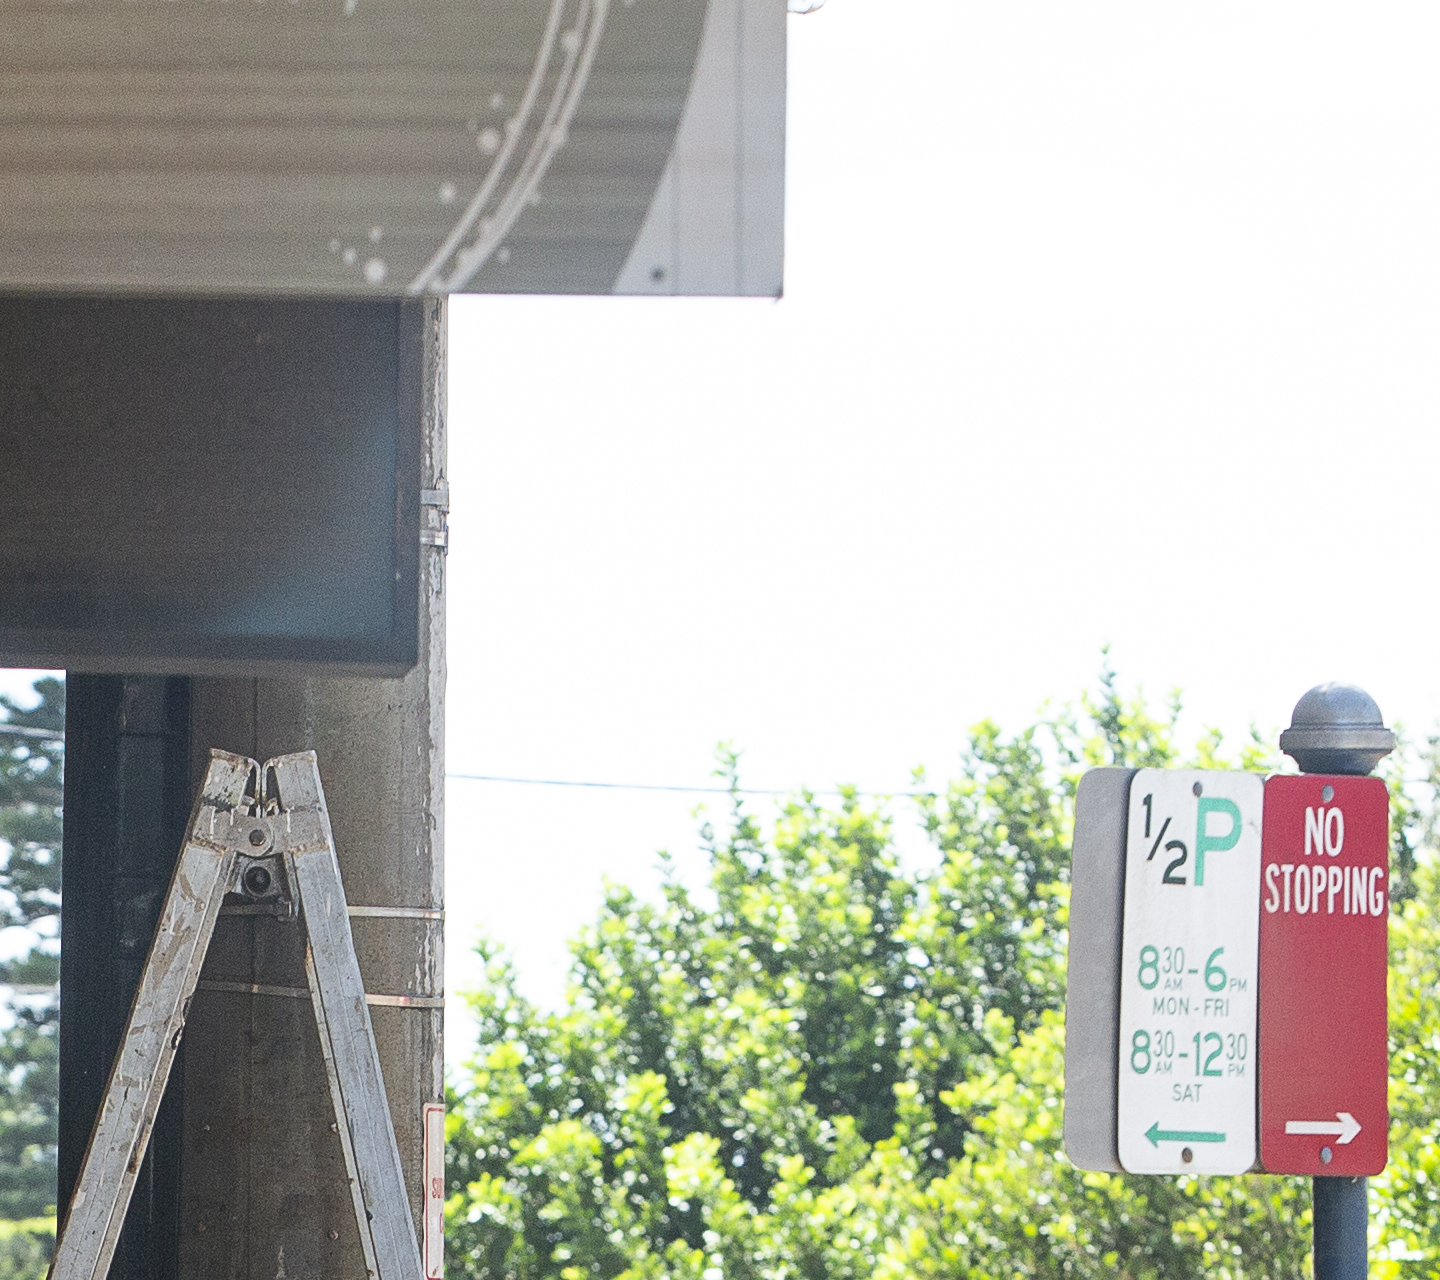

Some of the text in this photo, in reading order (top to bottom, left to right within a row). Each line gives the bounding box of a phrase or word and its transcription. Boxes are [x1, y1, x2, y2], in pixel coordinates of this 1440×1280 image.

[1305, 806, 1344, 857] NO
[1265, 864, 1385, 917] STOPPING
[1172, 1083, 1202, 1103] SAT
